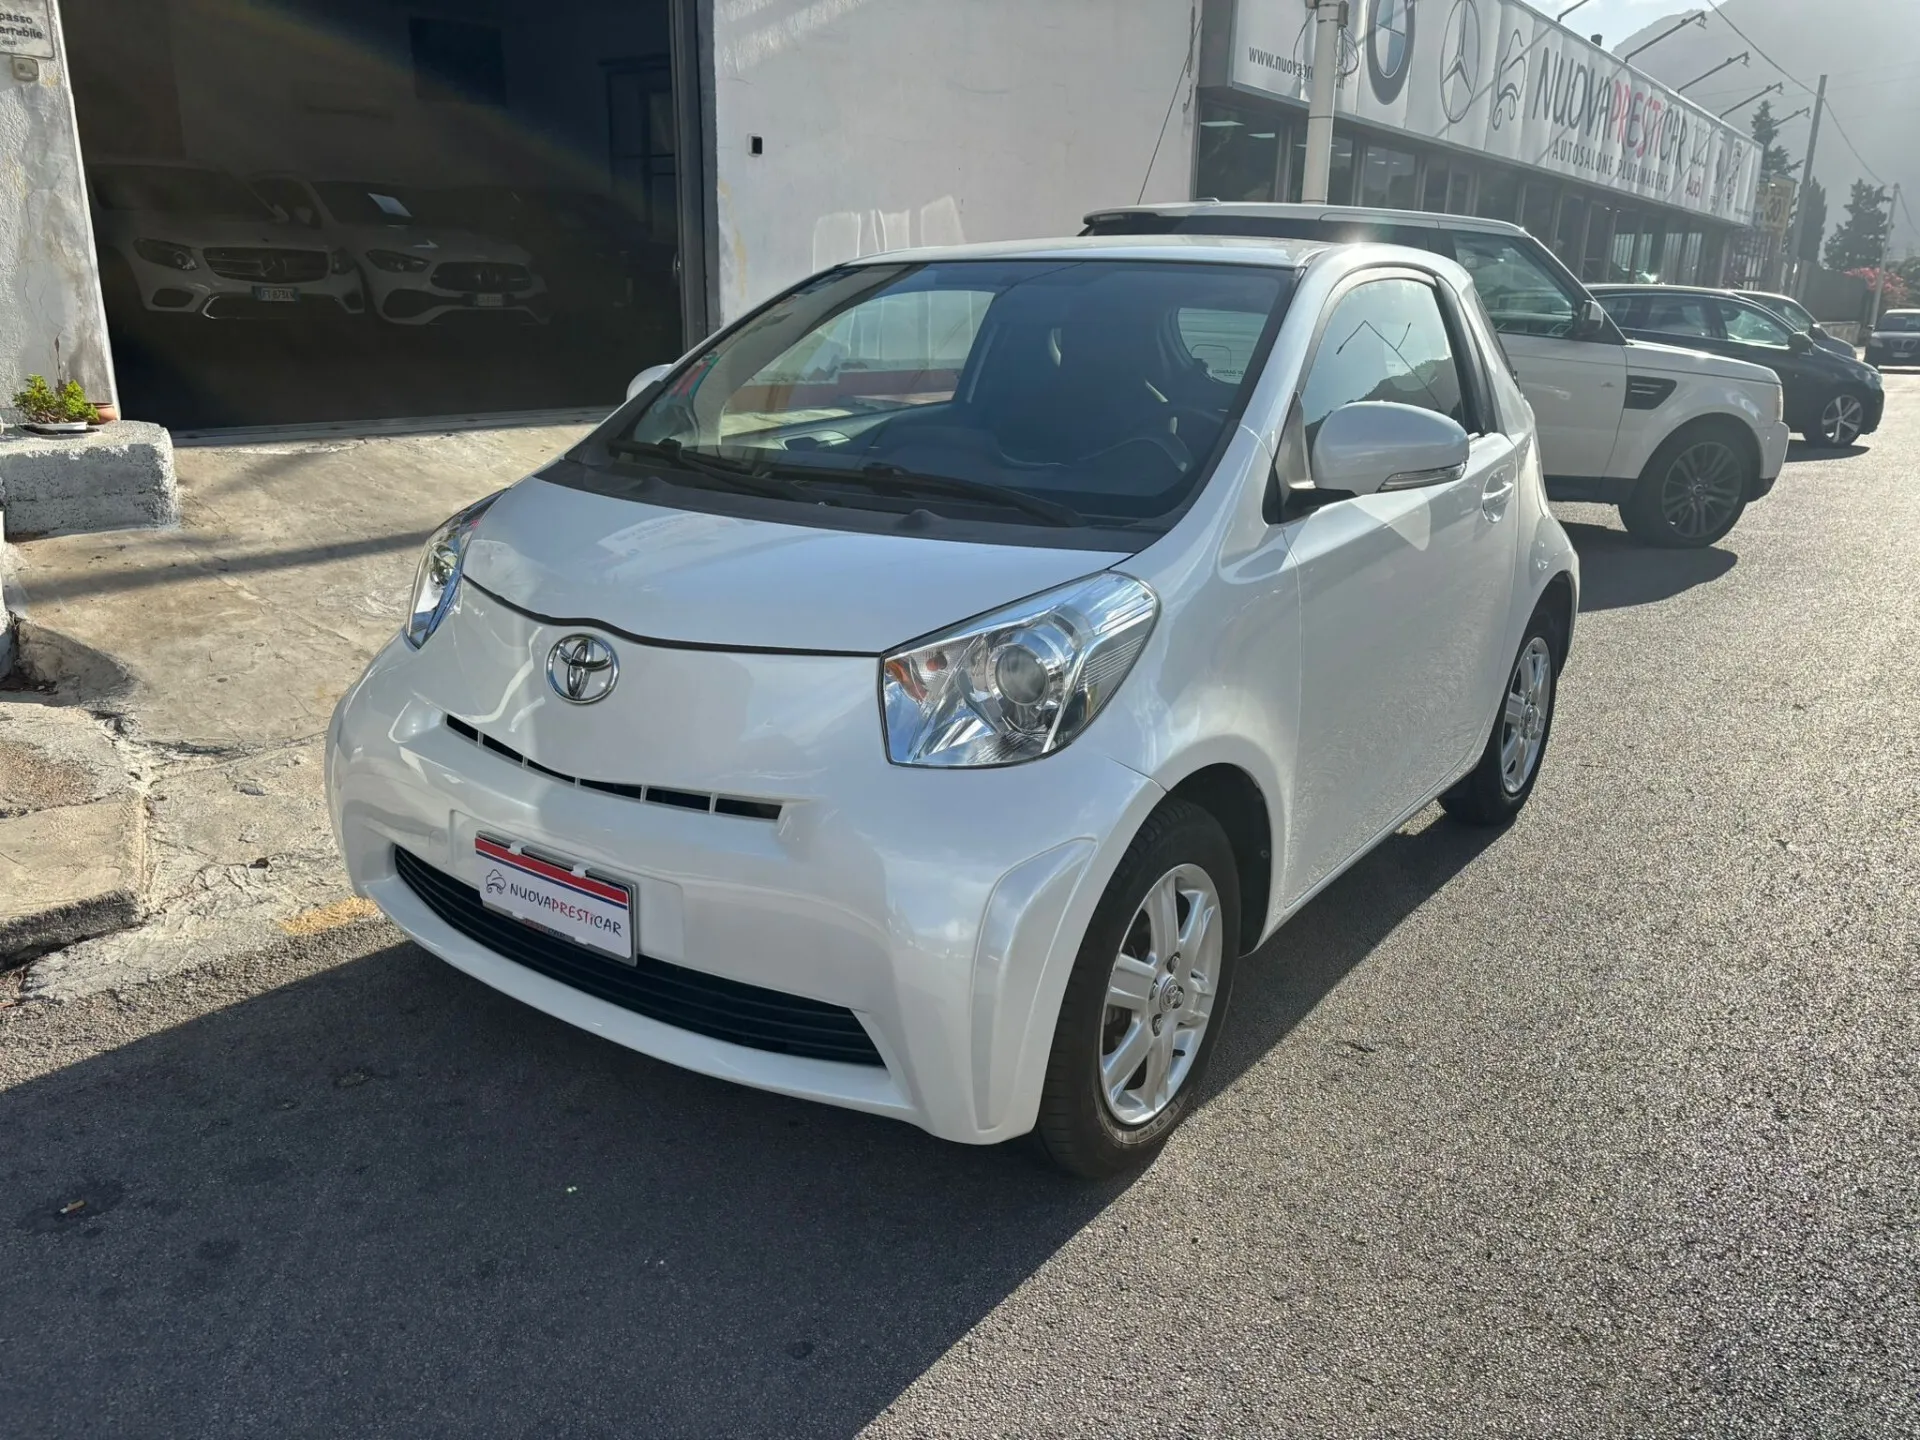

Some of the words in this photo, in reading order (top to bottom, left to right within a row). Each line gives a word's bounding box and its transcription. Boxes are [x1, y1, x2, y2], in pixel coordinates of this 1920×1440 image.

[0, 13, 33, 24] passo
[0, 26, 43, 39] arrabile
[1552, 138, 1613, 175] AUTOSALONE
